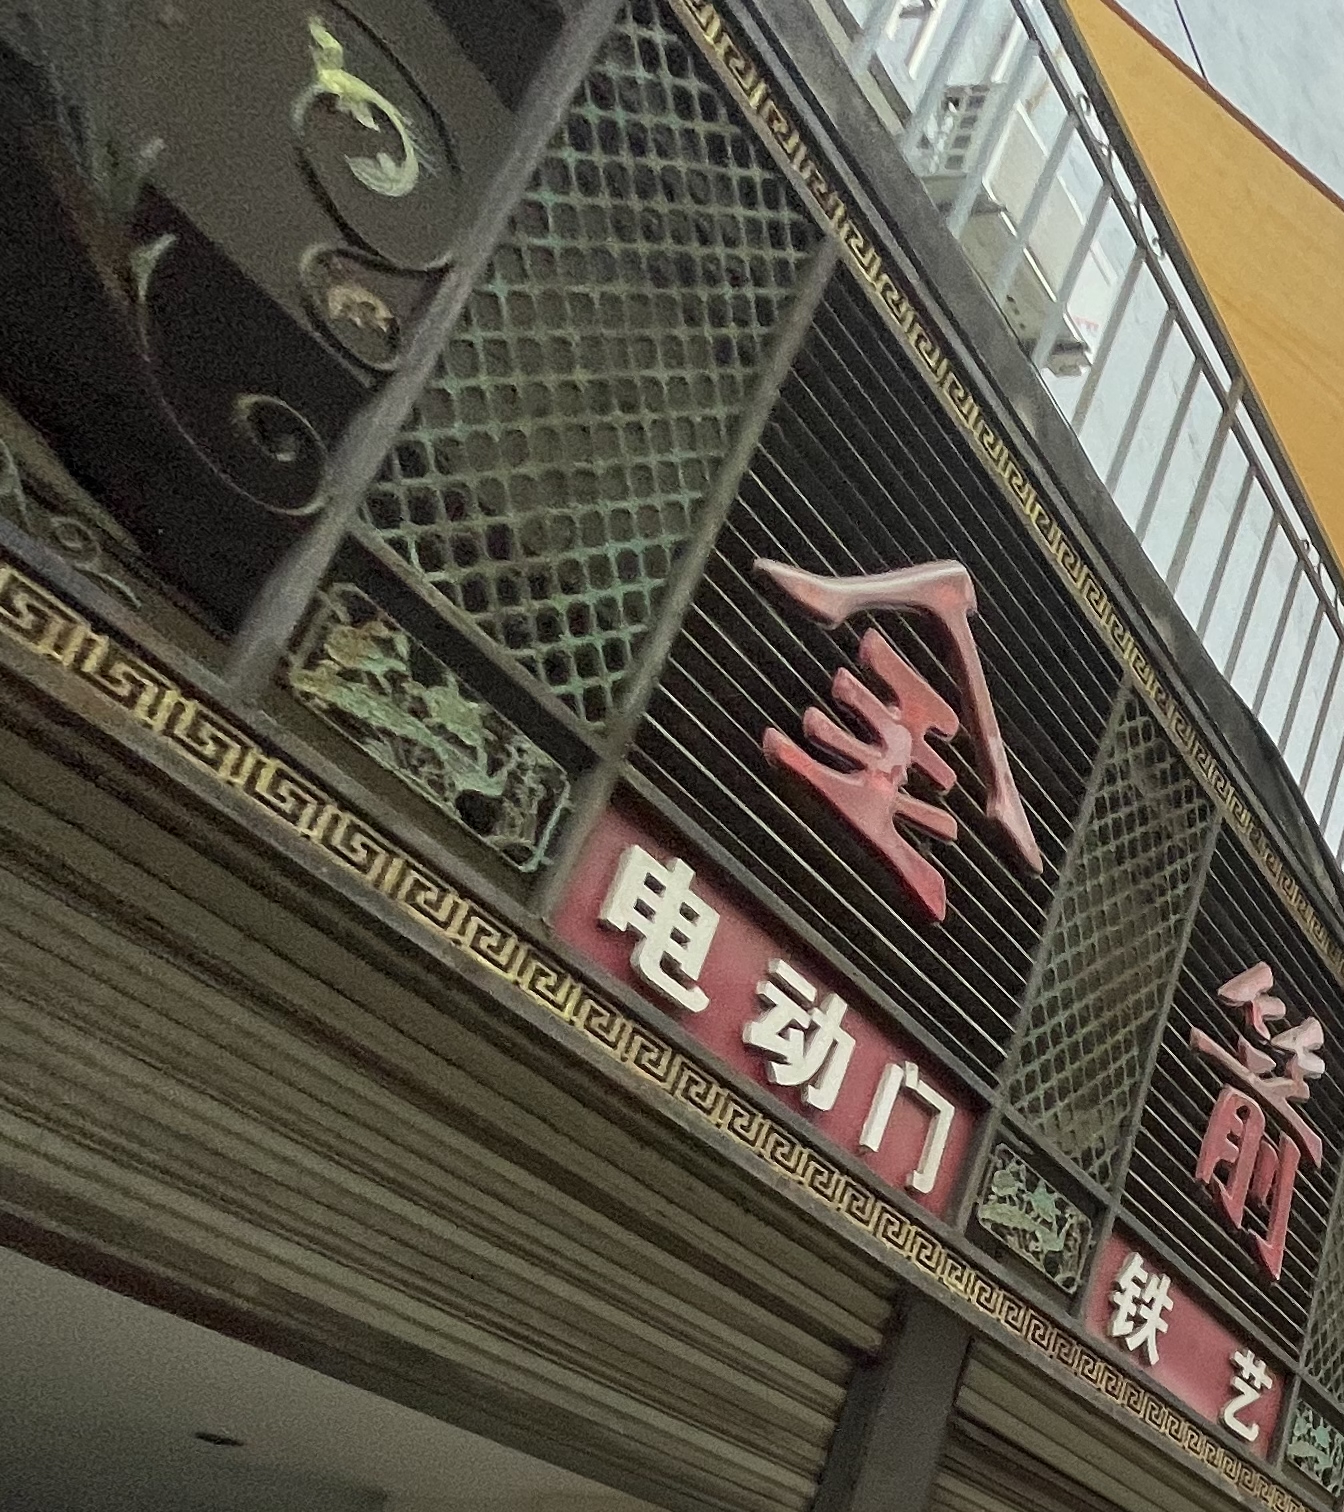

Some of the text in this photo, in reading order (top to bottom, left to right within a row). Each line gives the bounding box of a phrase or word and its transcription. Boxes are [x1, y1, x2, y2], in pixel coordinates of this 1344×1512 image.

[600, 844, 955, 1192] 电动门
[1109, 1252, 1274, 1443] 铁艺
